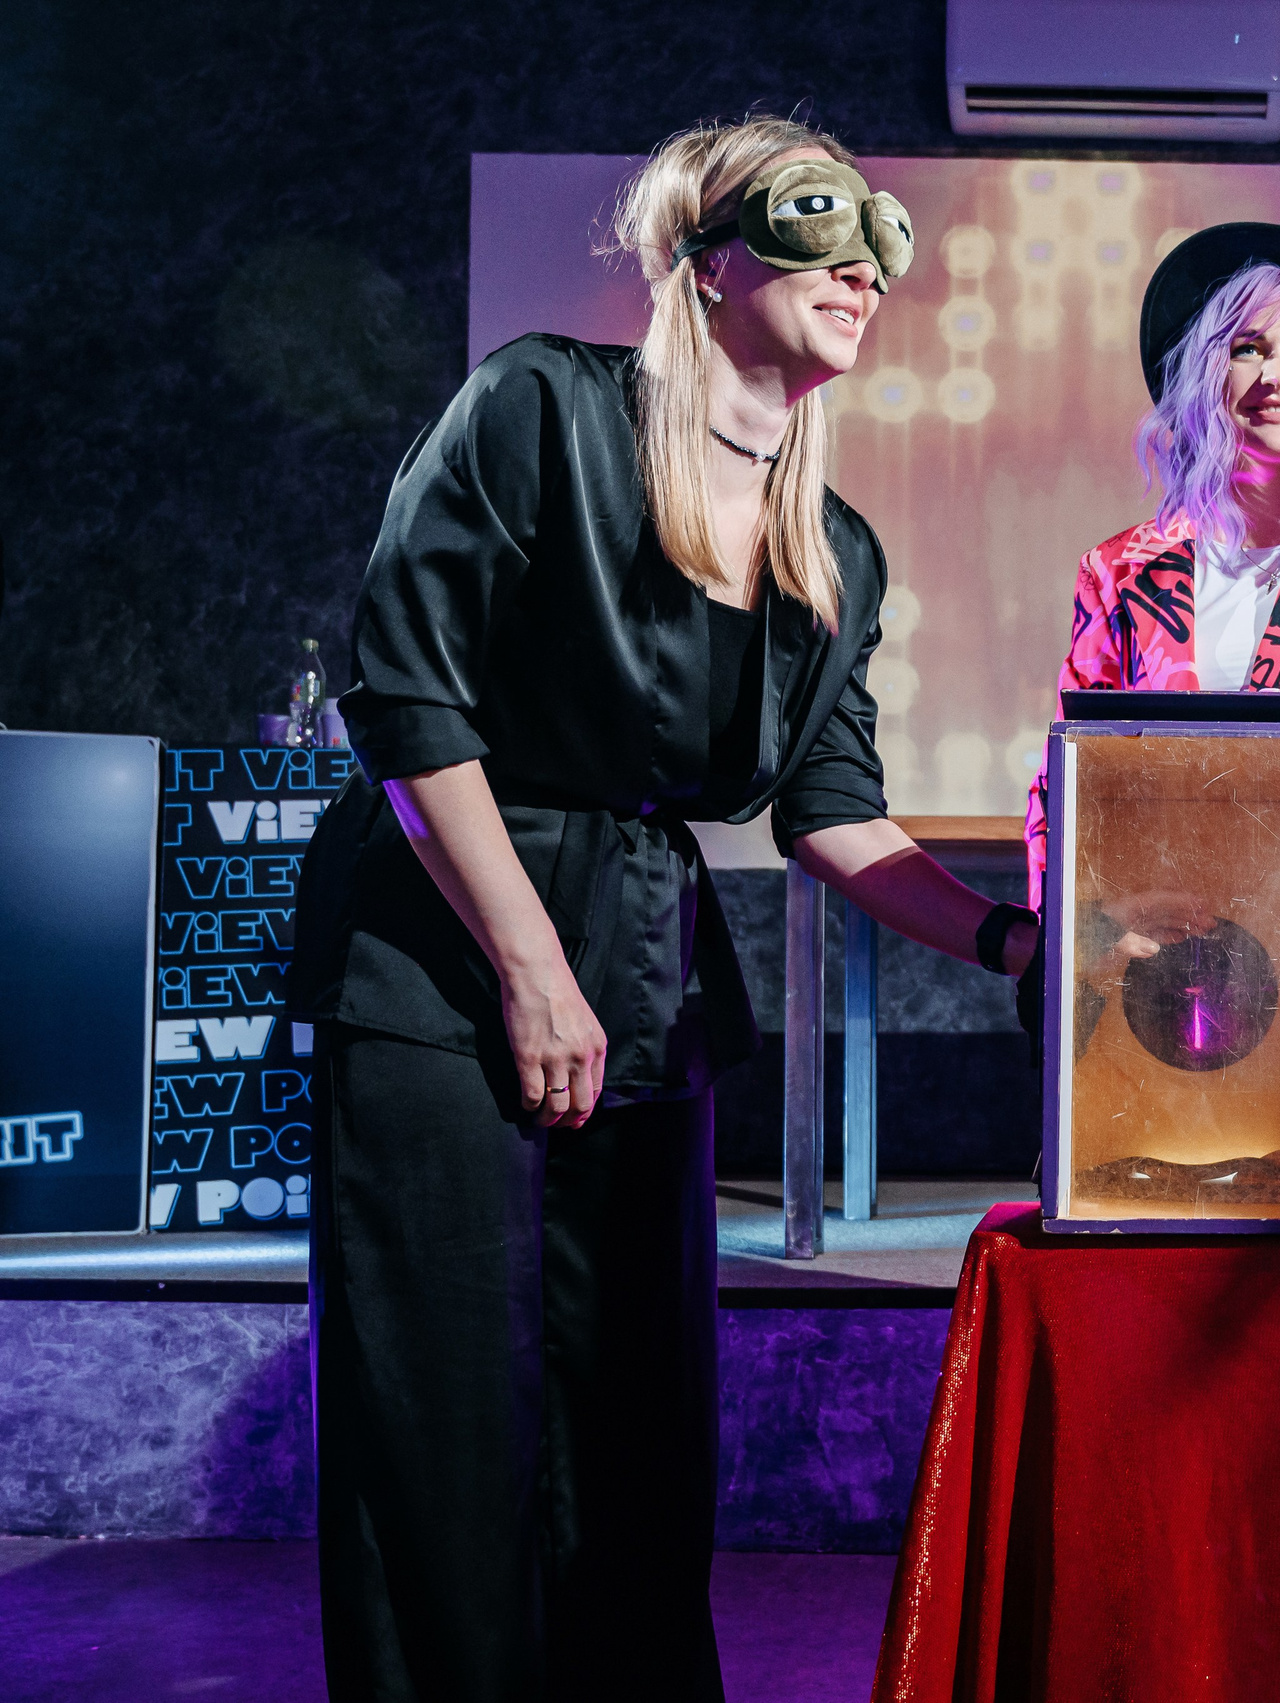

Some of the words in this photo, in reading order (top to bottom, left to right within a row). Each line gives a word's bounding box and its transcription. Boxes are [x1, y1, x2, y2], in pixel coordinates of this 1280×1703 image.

[207, 799, 331, 846] ViE
[176, 853, 304, 900] ViE
[196, 1172, 311, 1227] POi
